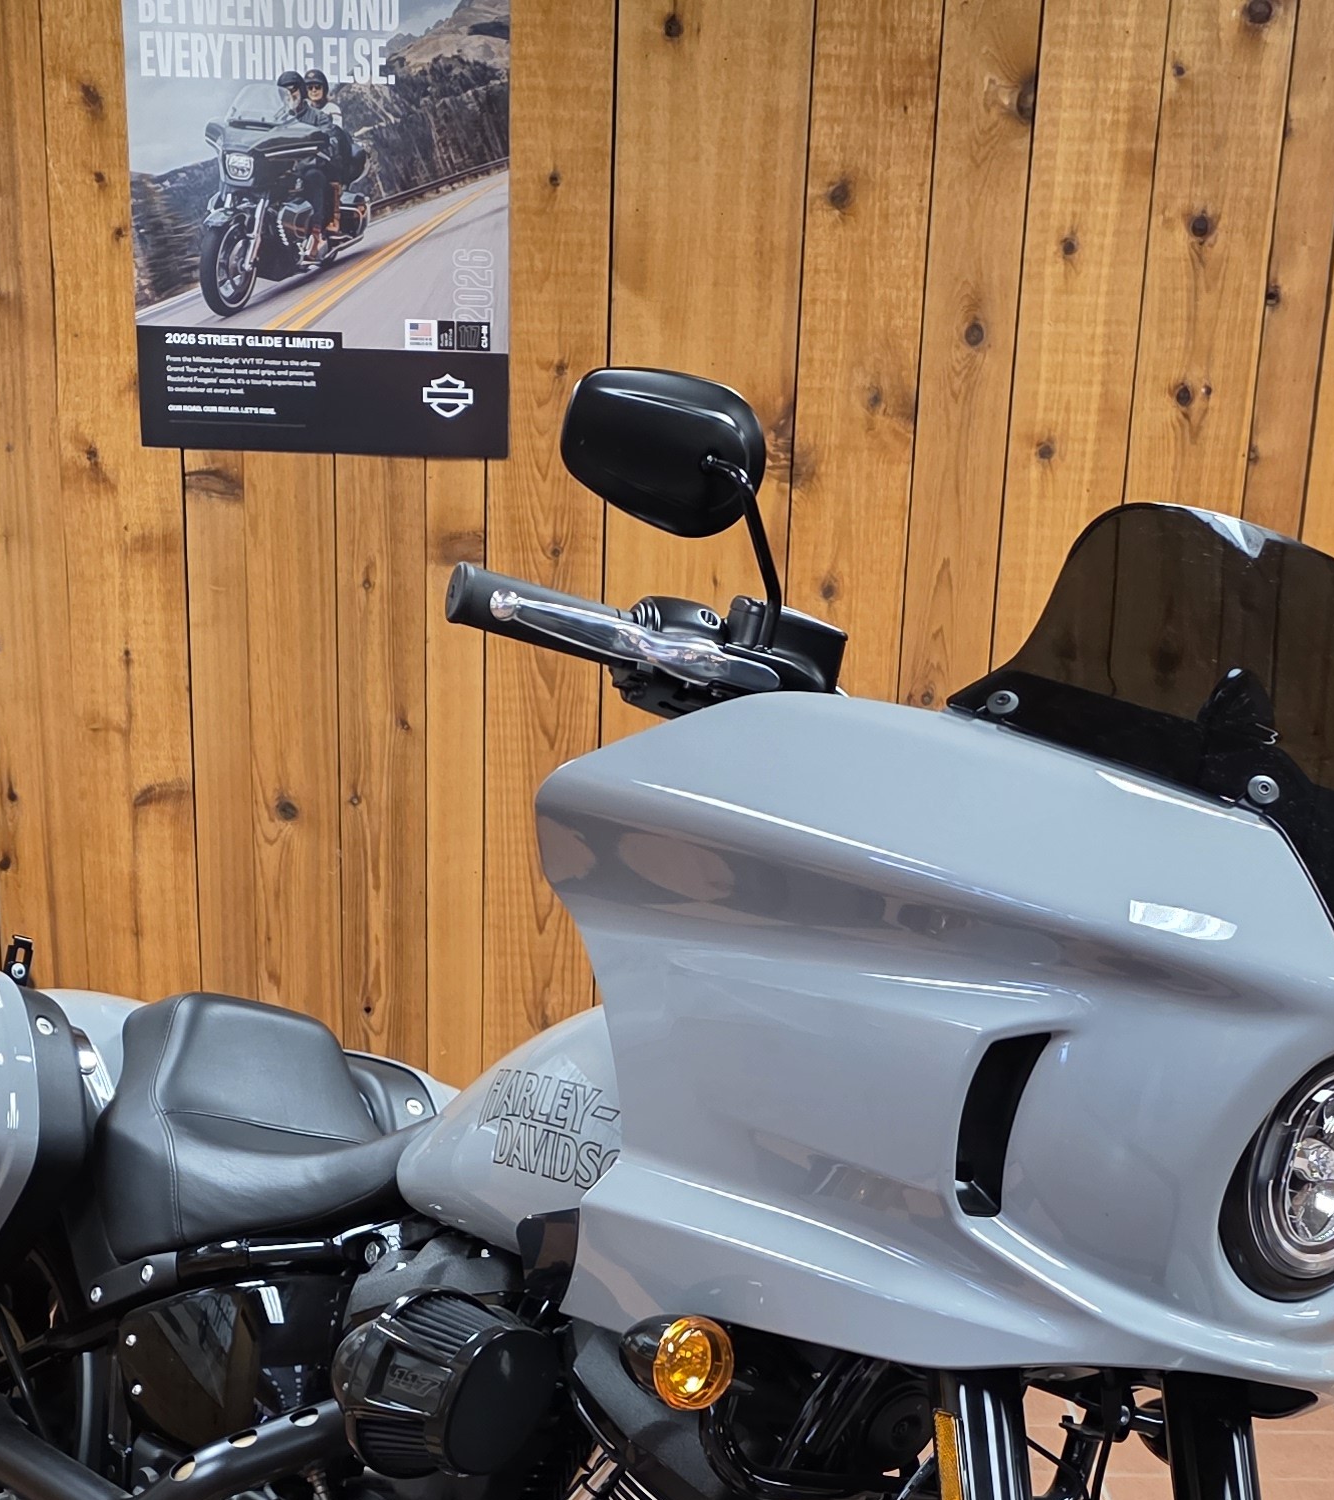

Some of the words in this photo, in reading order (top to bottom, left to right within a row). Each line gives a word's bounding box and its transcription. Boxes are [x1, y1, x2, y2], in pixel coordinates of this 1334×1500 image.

[137, 0, 275, 27] BETWEEN
[276, 0, 335, 30] YOU
[341, 0, 400, 31] AND
[139, 30, 316, 80] EVERYTHING
[322, 37, 396, 85] ELSE.
[452, 248, 494, 326] 2026
[165, 333, 196, 345] 2026
[198, 334, 245, 347] STREET
[246, 336, 283, 347] GLIDE
[285, 337, 335, 350] LIMITED
[476, 1069, 620, 1135] HARLEY-
[493, 1118, 621, 1190] DAVIDS
